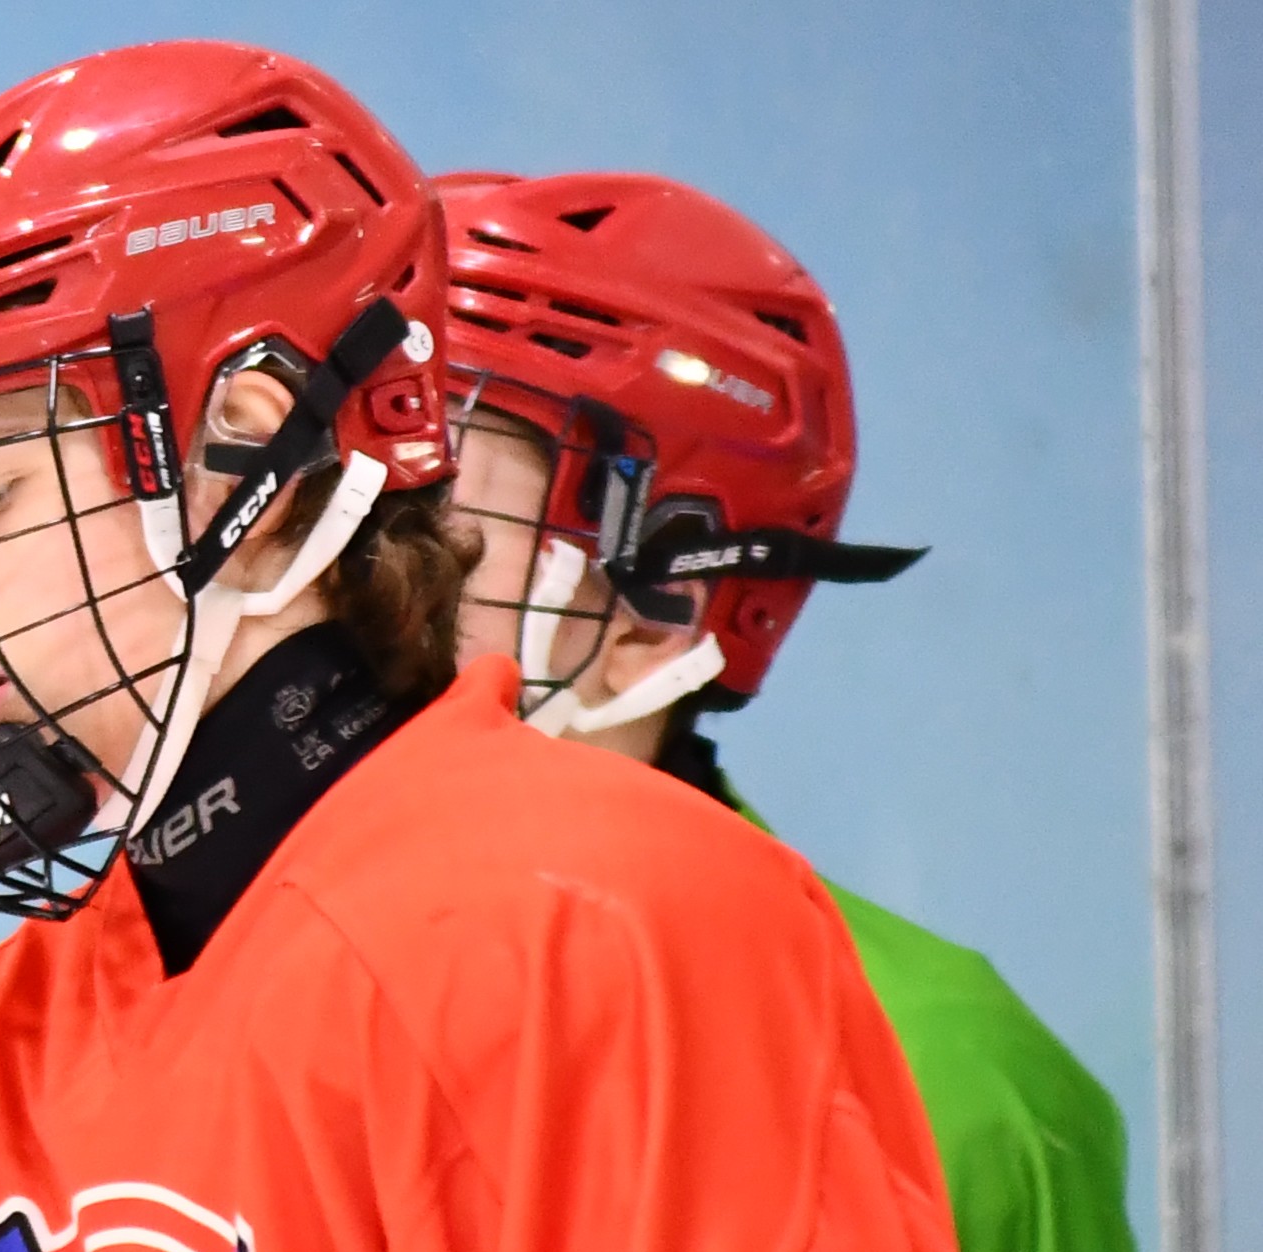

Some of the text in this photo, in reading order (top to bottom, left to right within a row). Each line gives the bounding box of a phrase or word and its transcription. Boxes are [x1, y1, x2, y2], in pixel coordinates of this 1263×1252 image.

[125, 202, 277, 257] BAUER
[220, 470, 278, 549] CCM
[125, 776, 242, 866] UER
